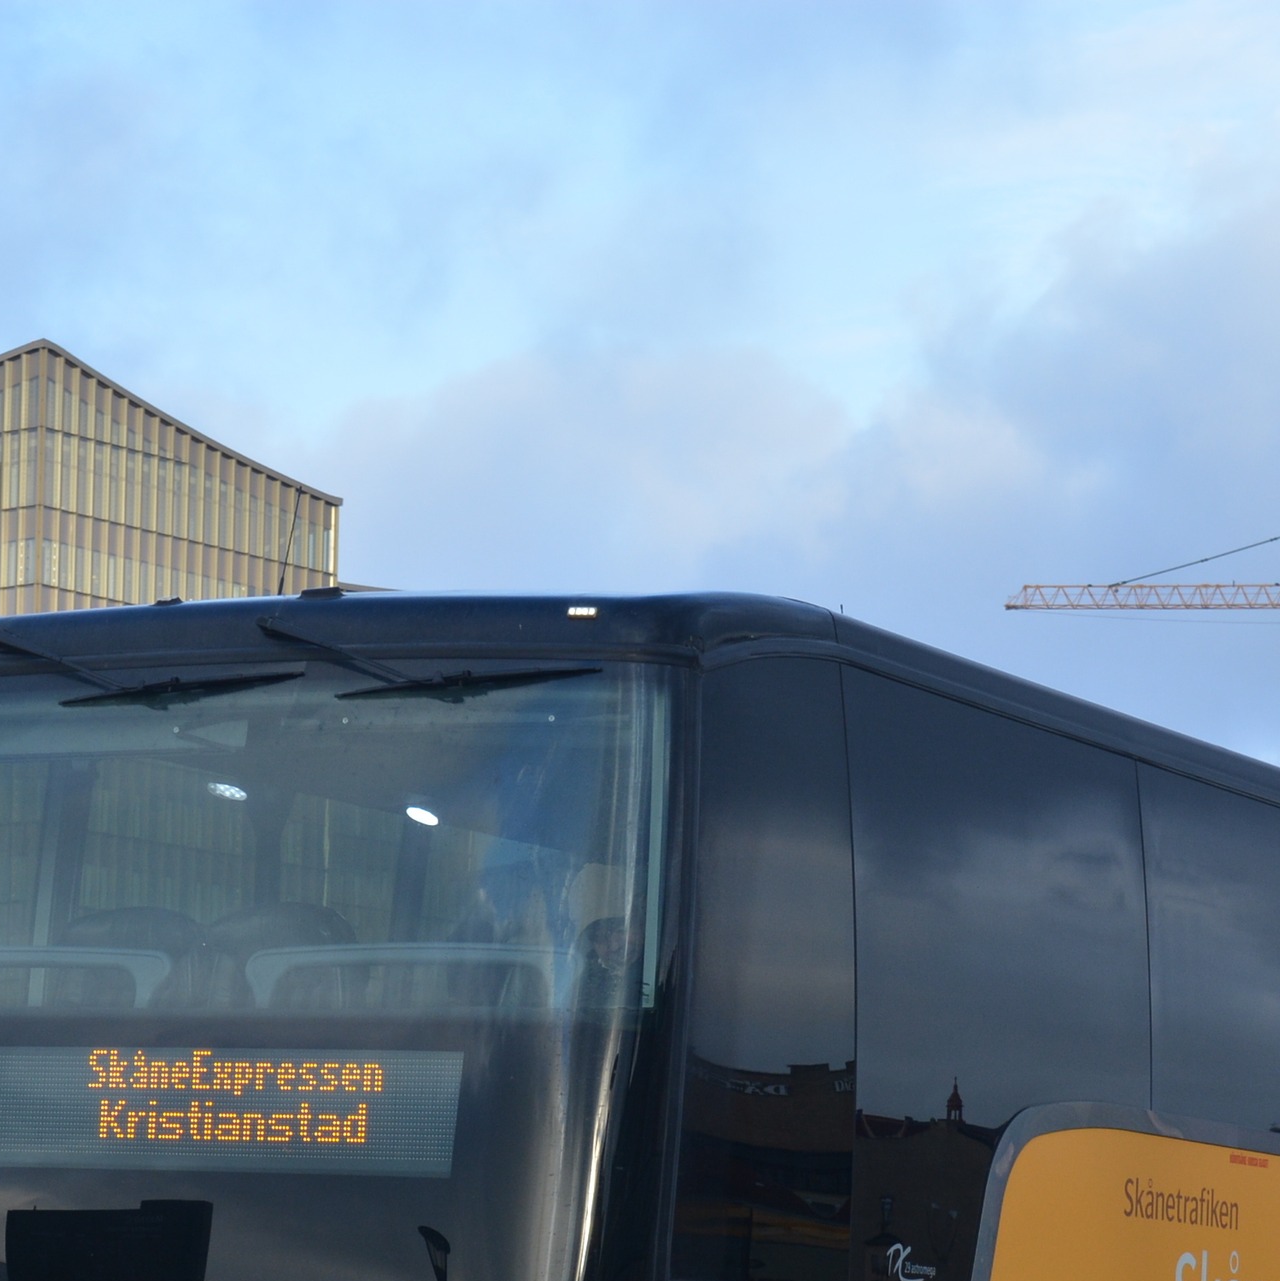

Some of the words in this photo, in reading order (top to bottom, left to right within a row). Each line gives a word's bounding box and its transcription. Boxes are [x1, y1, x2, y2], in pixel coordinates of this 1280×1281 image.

[88, 1049, 383, 1095] SkåneExpressen
[99, 1100, 367, 1143] Kristianstad
[1124, 1177, 1239, 1230] Skånetrafiken
